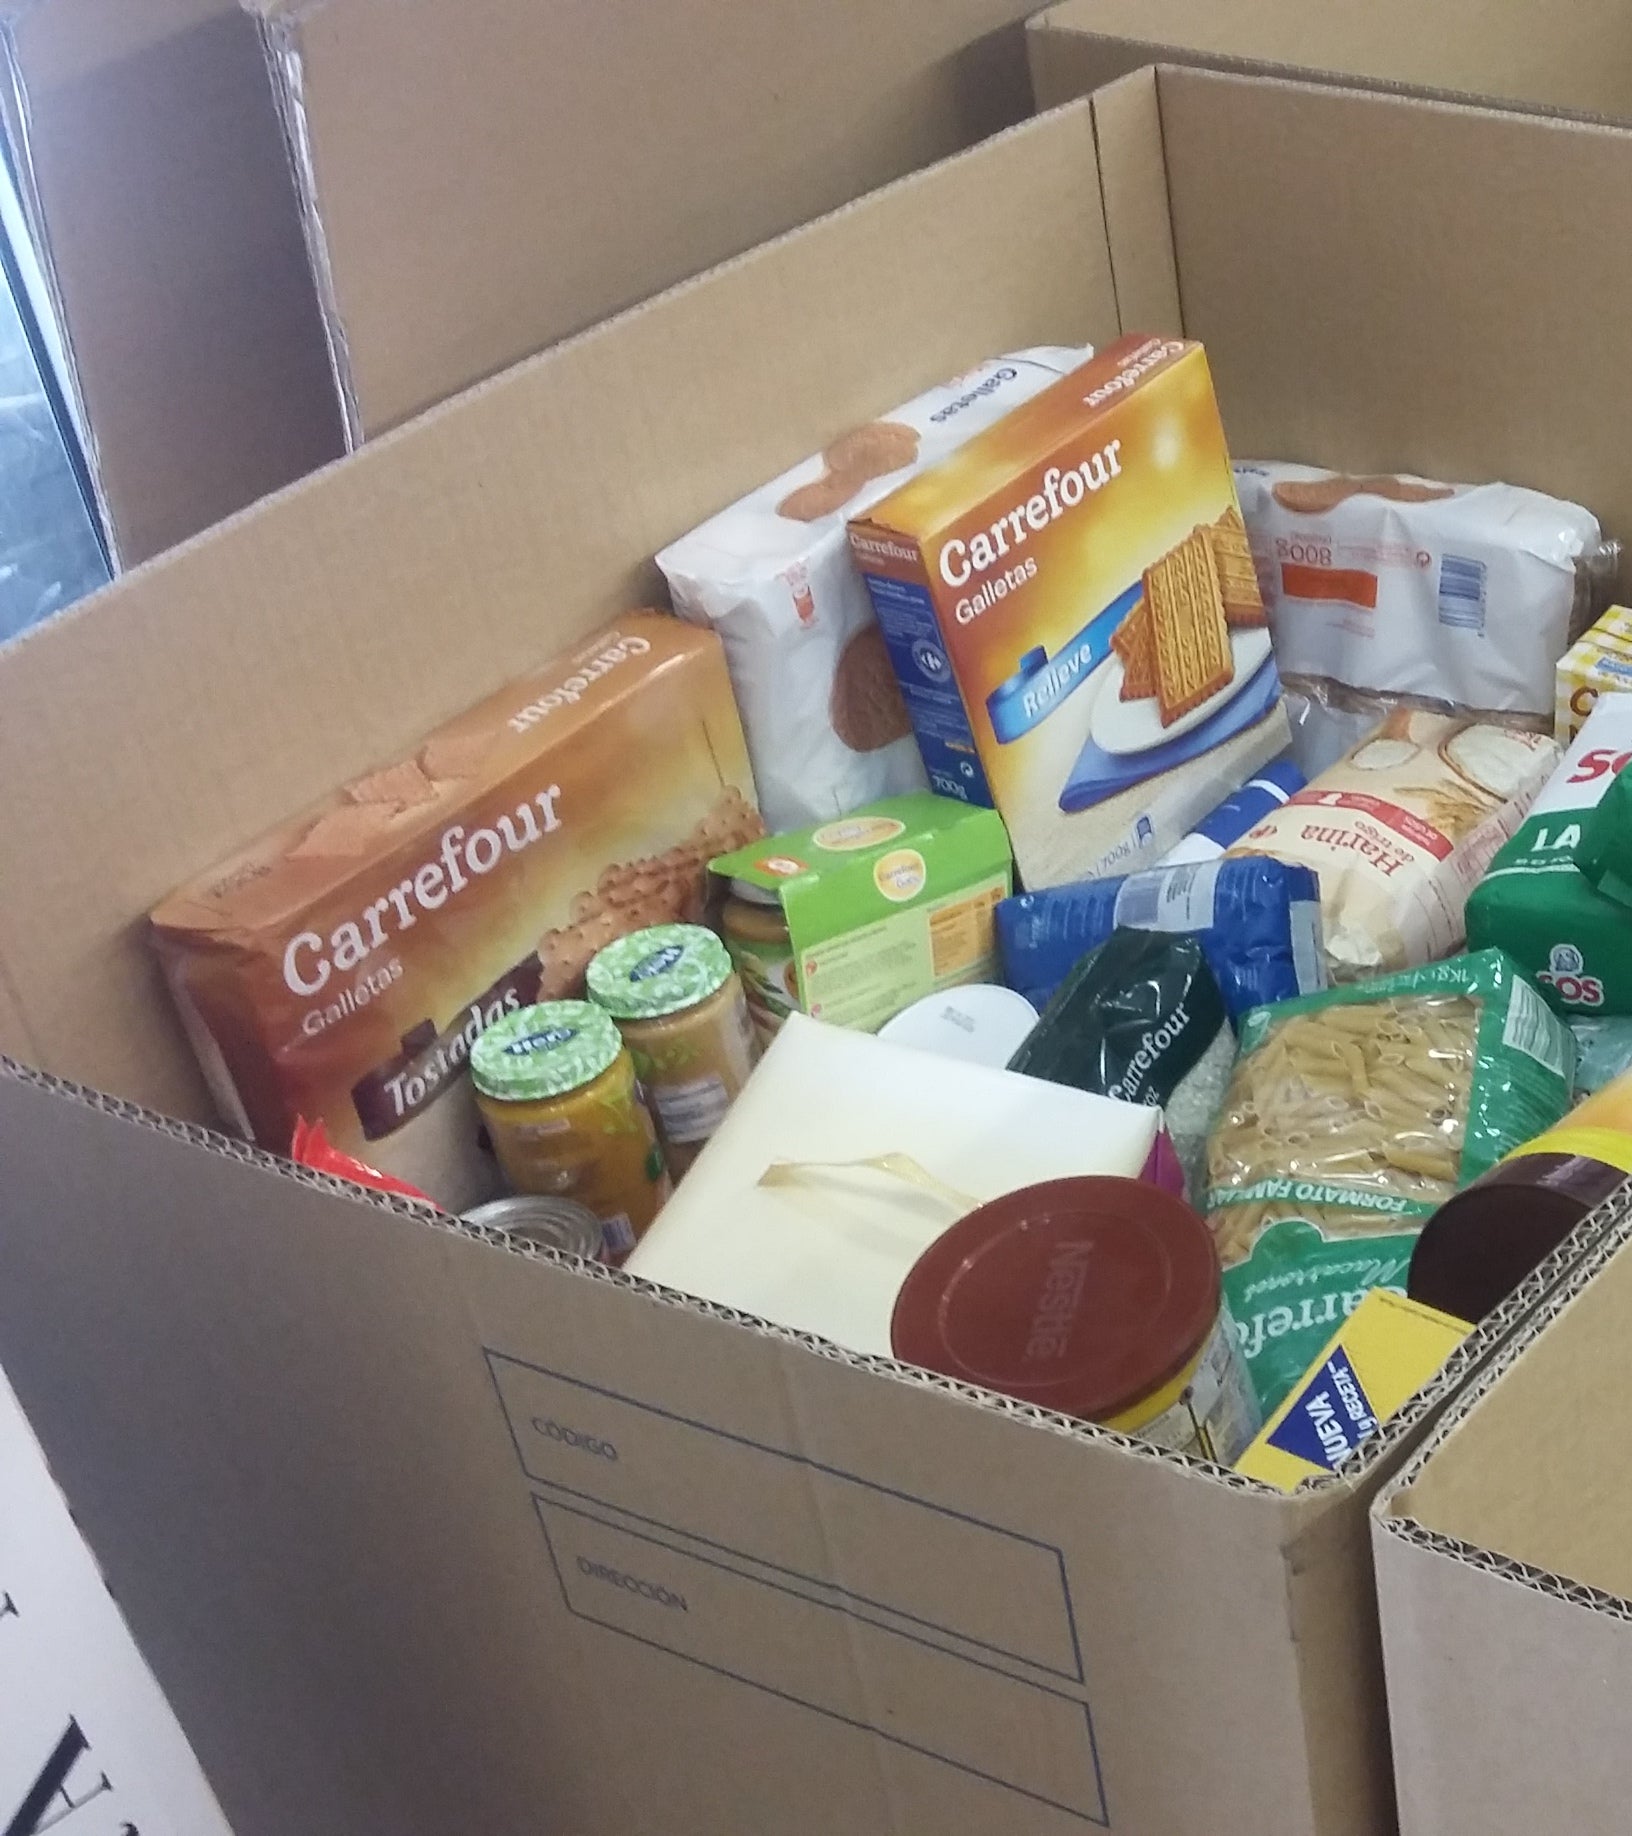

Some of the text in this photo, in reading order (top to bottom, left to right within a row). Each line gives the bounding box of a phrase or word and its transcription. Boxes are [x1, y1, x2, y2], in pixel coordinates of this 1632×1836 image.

[939, 439, 1122, 587] Carrefour
[955, 557, 1038, 625] Galletas
[507, 636, 651, 733] Carrefour
[1023, 644, 1092, 718] Relieve
[1300, 824, 1405, 877] Harina
[283, 784, 562, 997] Carrefour
[301, 958, 405, 1037] Galletas
[1108, 1002, 1190, 1103] Carrefour
[1295, 1181, 1408, 1212] FORMATO
[1234, 1285, 1408, 1359] arref
[1305, 1390, 1353, 1473] NUEVA
